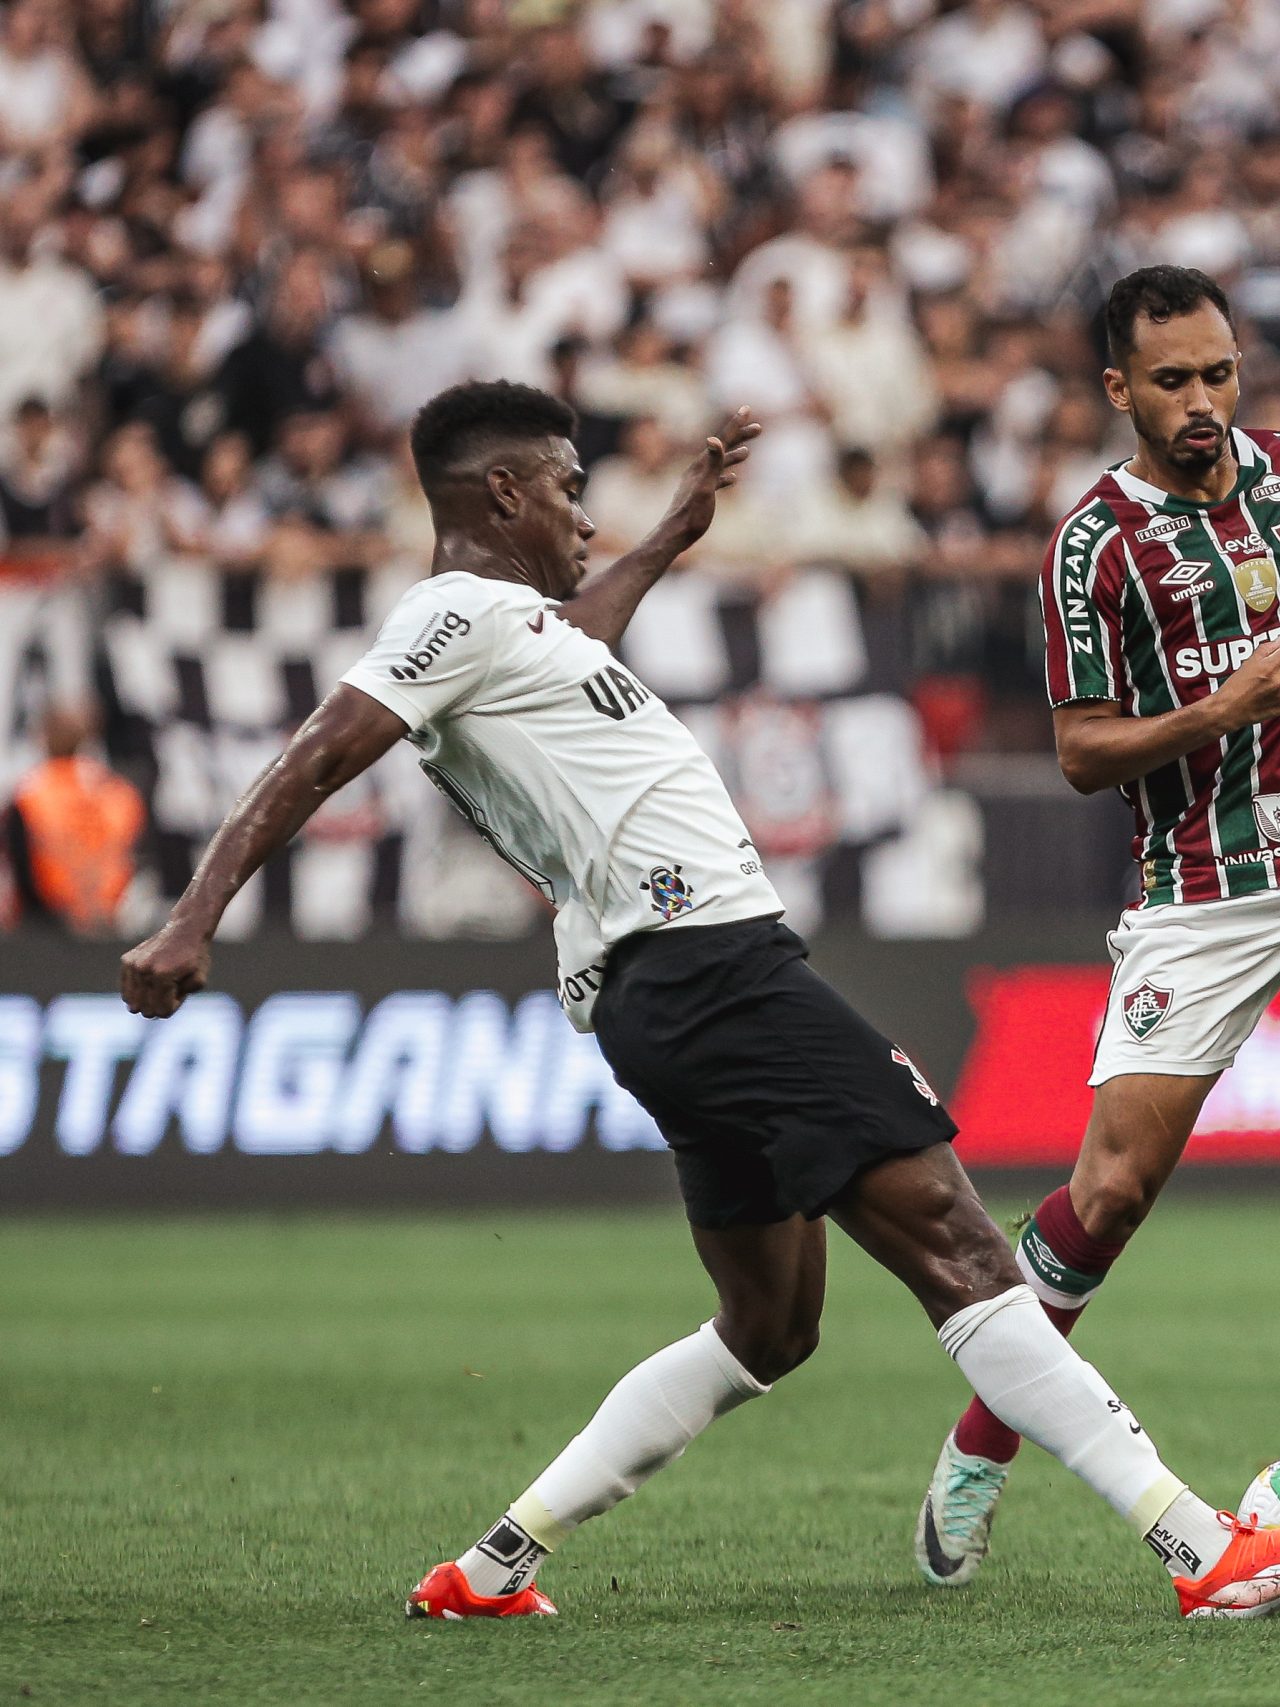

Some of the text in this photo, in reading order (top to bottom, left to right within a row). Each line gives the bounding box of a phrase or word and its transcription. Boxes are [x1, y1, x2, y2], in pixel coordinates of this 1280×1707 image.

[1139, 519, 1188, 541] FRESCATTO
[1212, 533, 1262, 554] Leve
[1065, 513, 1105, 655] ZINZANE
[1171, 580, 1214, 602] umbro
[404, 610, 471, 673] bmg
